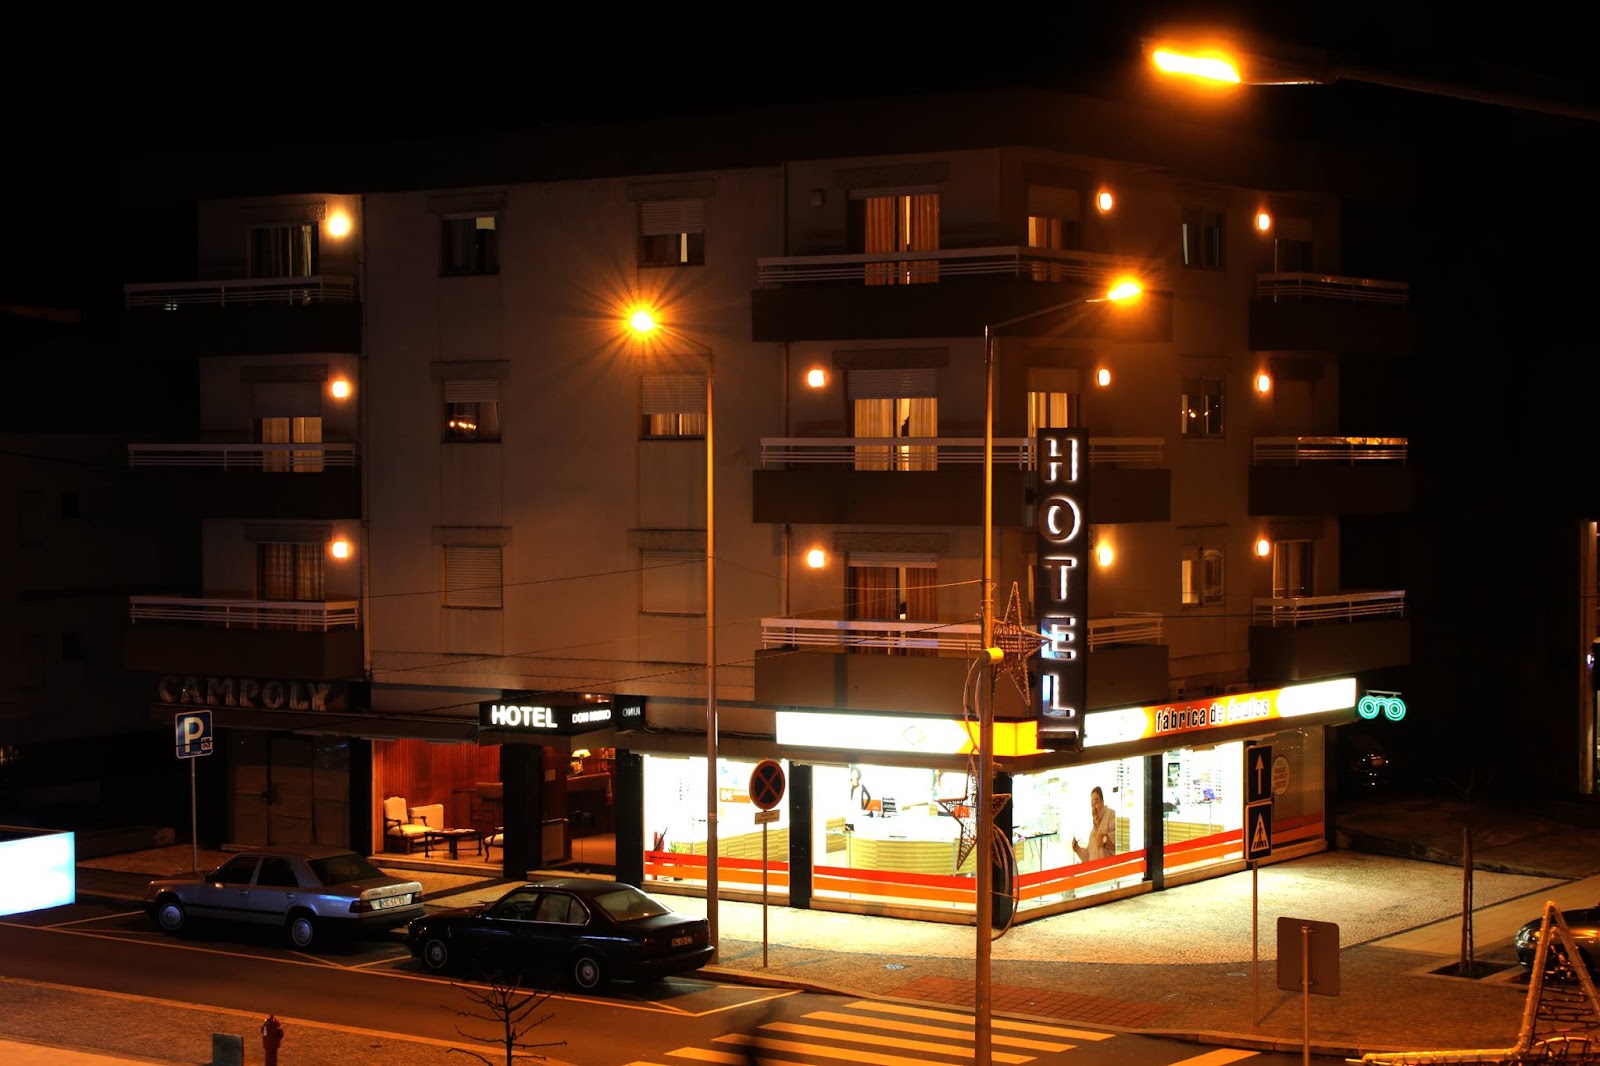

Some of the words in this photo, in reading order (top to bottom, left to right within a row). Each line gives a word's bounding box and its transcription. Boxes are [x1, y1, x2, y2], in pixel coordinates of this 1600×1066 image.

[1038, 438, 1081, 718] HOTEL
[158, 674, 332, 712] CAMPOLY
[183, 716, 205, 753] P
[491, 705, 558, 728] HOTEL
[1155, 707, 1206, 733] fábrica
[1210, 703, 1225, 725] de
